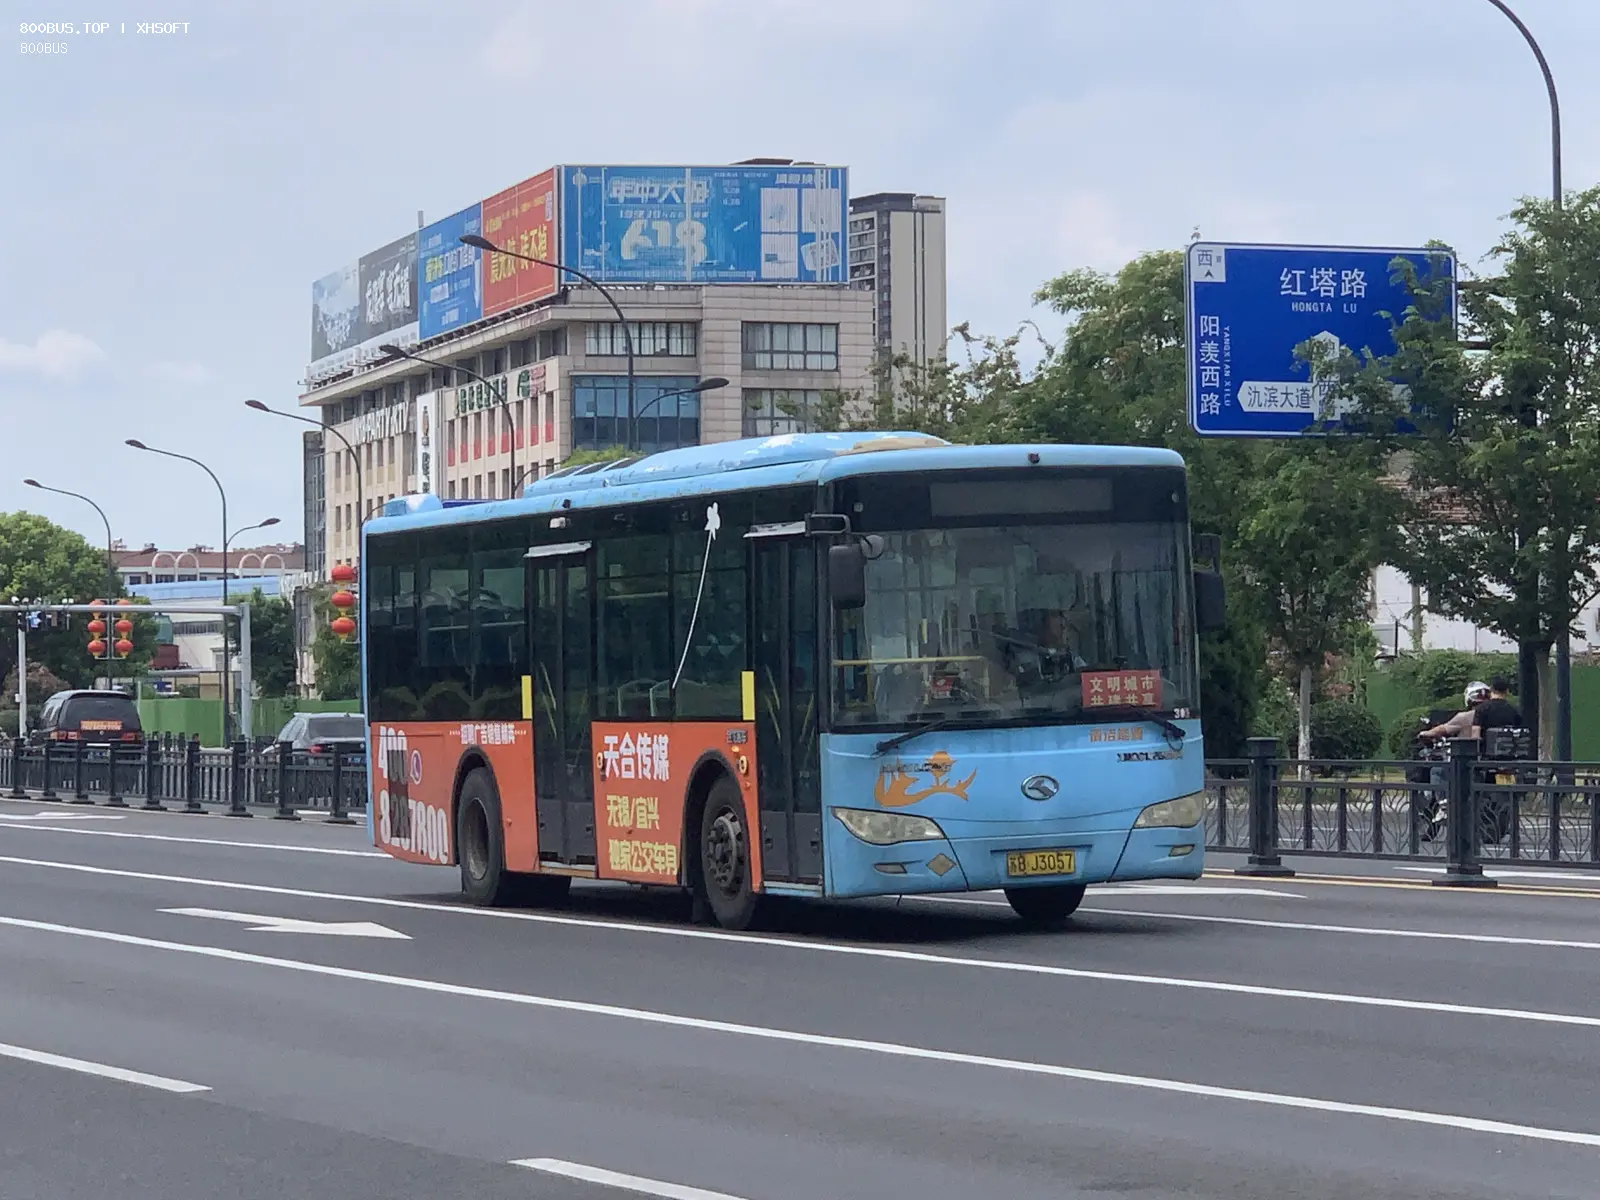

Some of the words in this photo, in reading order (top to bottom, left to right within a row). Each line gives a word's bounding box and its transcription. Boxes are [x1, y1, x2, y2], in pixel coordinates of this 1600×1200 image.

[621, 219, 707, 264] 618
[1197, 249, 1213, 267] 西
[1280, 267, 1368, 299] 红塔路
[1291, 302, 1333, 313] HONGTA
[1343, 303, 1357, 314] LU
[1199, 315, 1221, 416] 阳羡西路
[1247, 385, 1311, 409] 氿滨大道
[1089, 675, 1157, 694] 文明城市
[603, 731, 670, 782] 天合传媒
[606, 794, 660, 830] 无锡/宜兴
[1031, 852, 1073, 871] J3057
